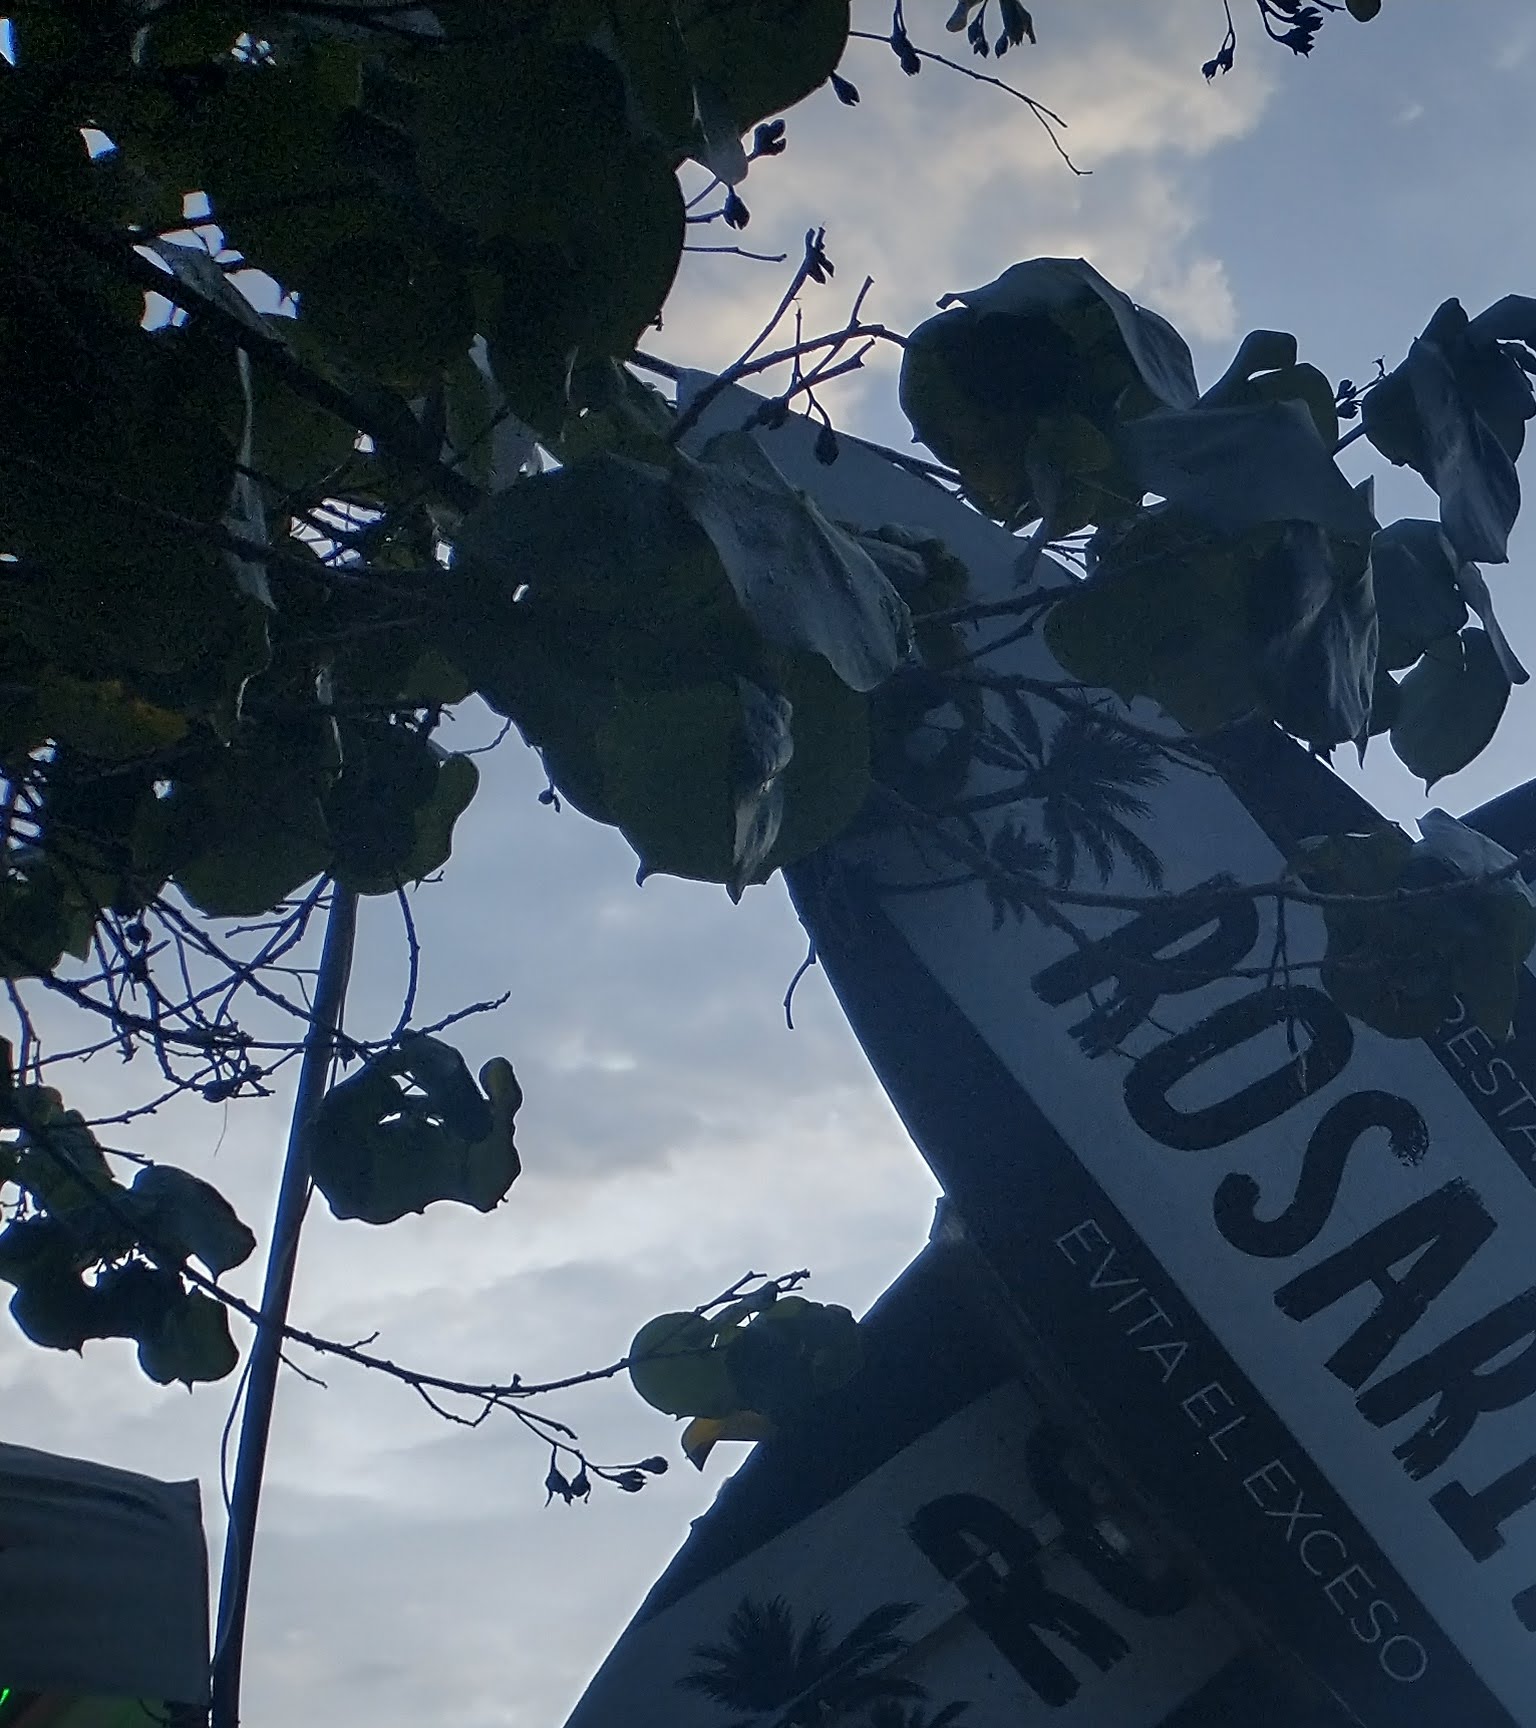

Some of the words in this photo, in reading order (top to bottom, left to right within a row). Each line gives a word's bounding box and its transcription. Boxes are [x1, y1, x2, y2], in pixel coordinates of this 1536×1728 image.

[1054, 1217, 1189, 1384] EVITA
[1181, 1380, 1247, 1462] EL
[1242, 1458, 1429, 1683] EXCESO
